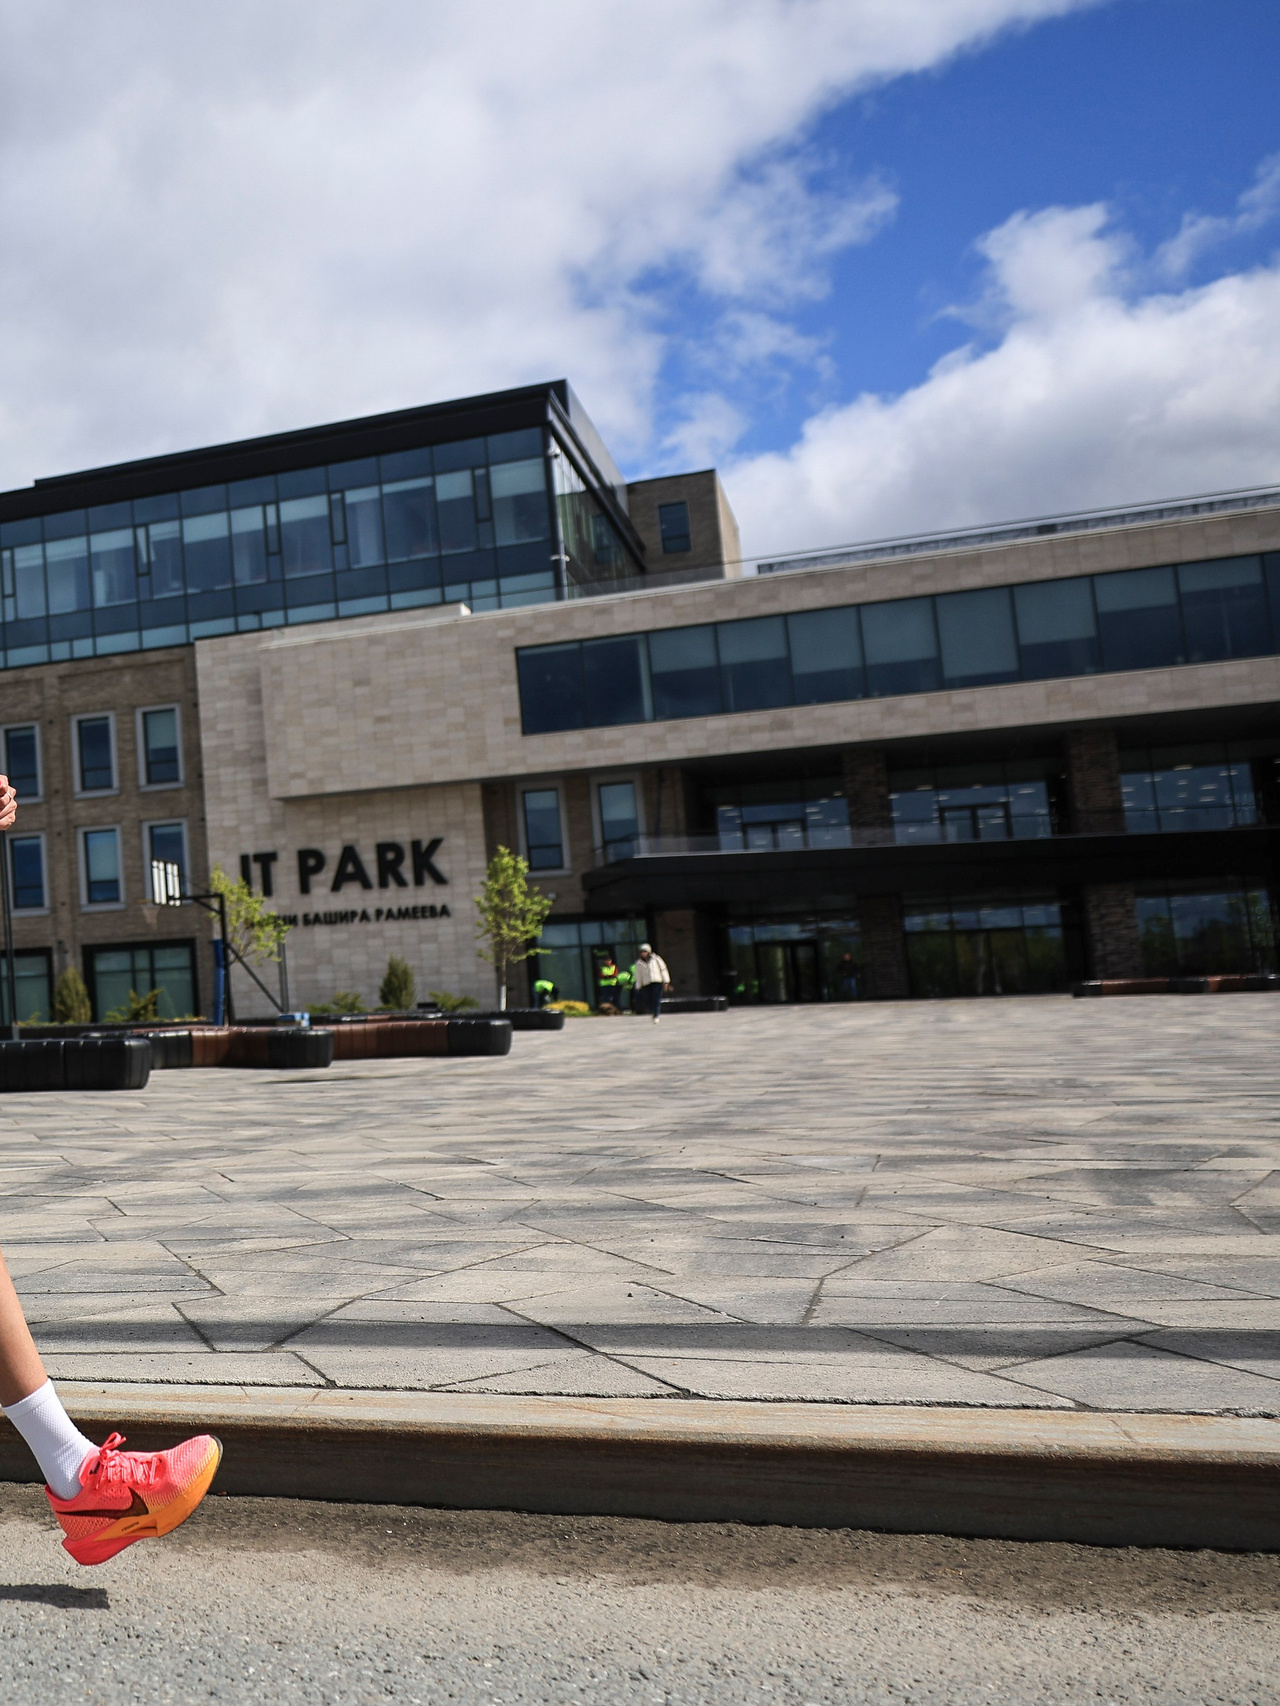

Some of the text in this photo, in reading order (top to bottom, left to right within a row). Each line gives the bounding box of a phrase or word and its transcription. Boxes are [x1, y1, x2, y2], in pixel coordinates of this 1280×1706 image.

[240, 838, 448, 897] IT PARK
[302, 908, 371, 926] БАШИРА
[375, 904, 451, 922] РАМЕЕВА
